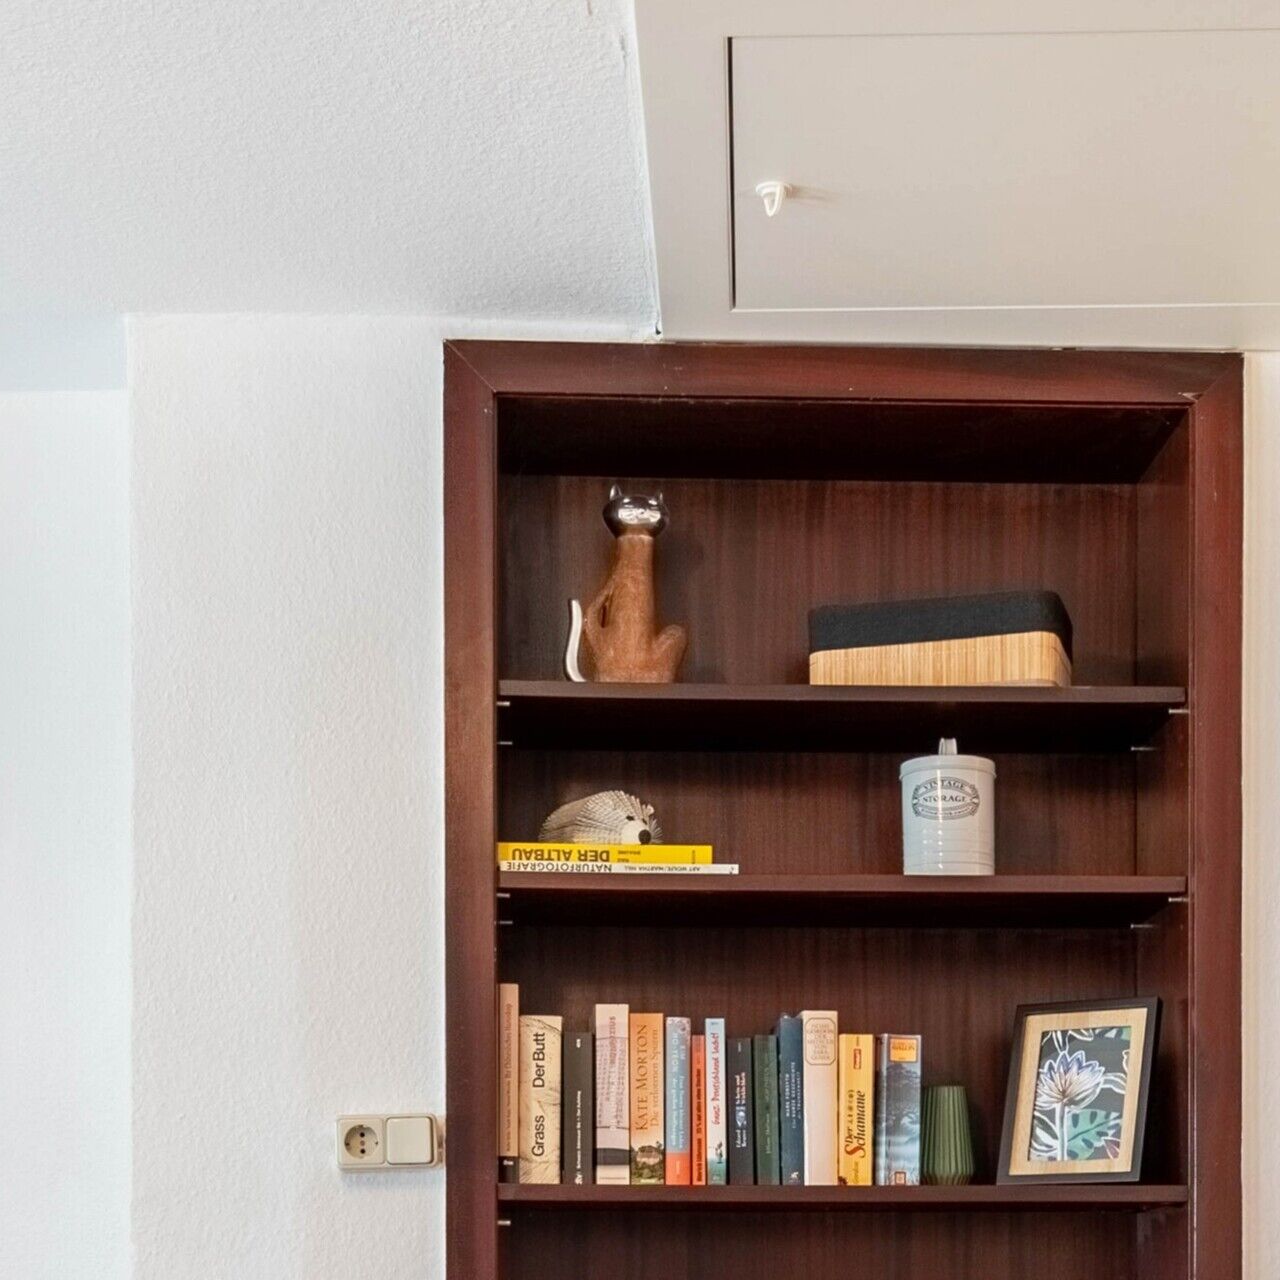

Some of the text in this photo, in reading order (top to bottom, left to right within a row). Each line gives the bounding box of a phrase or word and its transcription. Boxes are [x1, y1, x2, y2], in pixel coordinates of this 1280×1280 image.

[923, 779, 967, 790] VINTAGE
[511, 848, 610, 862] DER ALTBAU
[507, 861, 612, 872] NATURFOTOGRAFIE
[635, 1024, 648, 1130] KATE MORTON
[531, 1032, 545, 1157] Grass Der Butt
[844, 1090, 866, 1159] Schamane
[844, 1126, 853, 1144] Der
